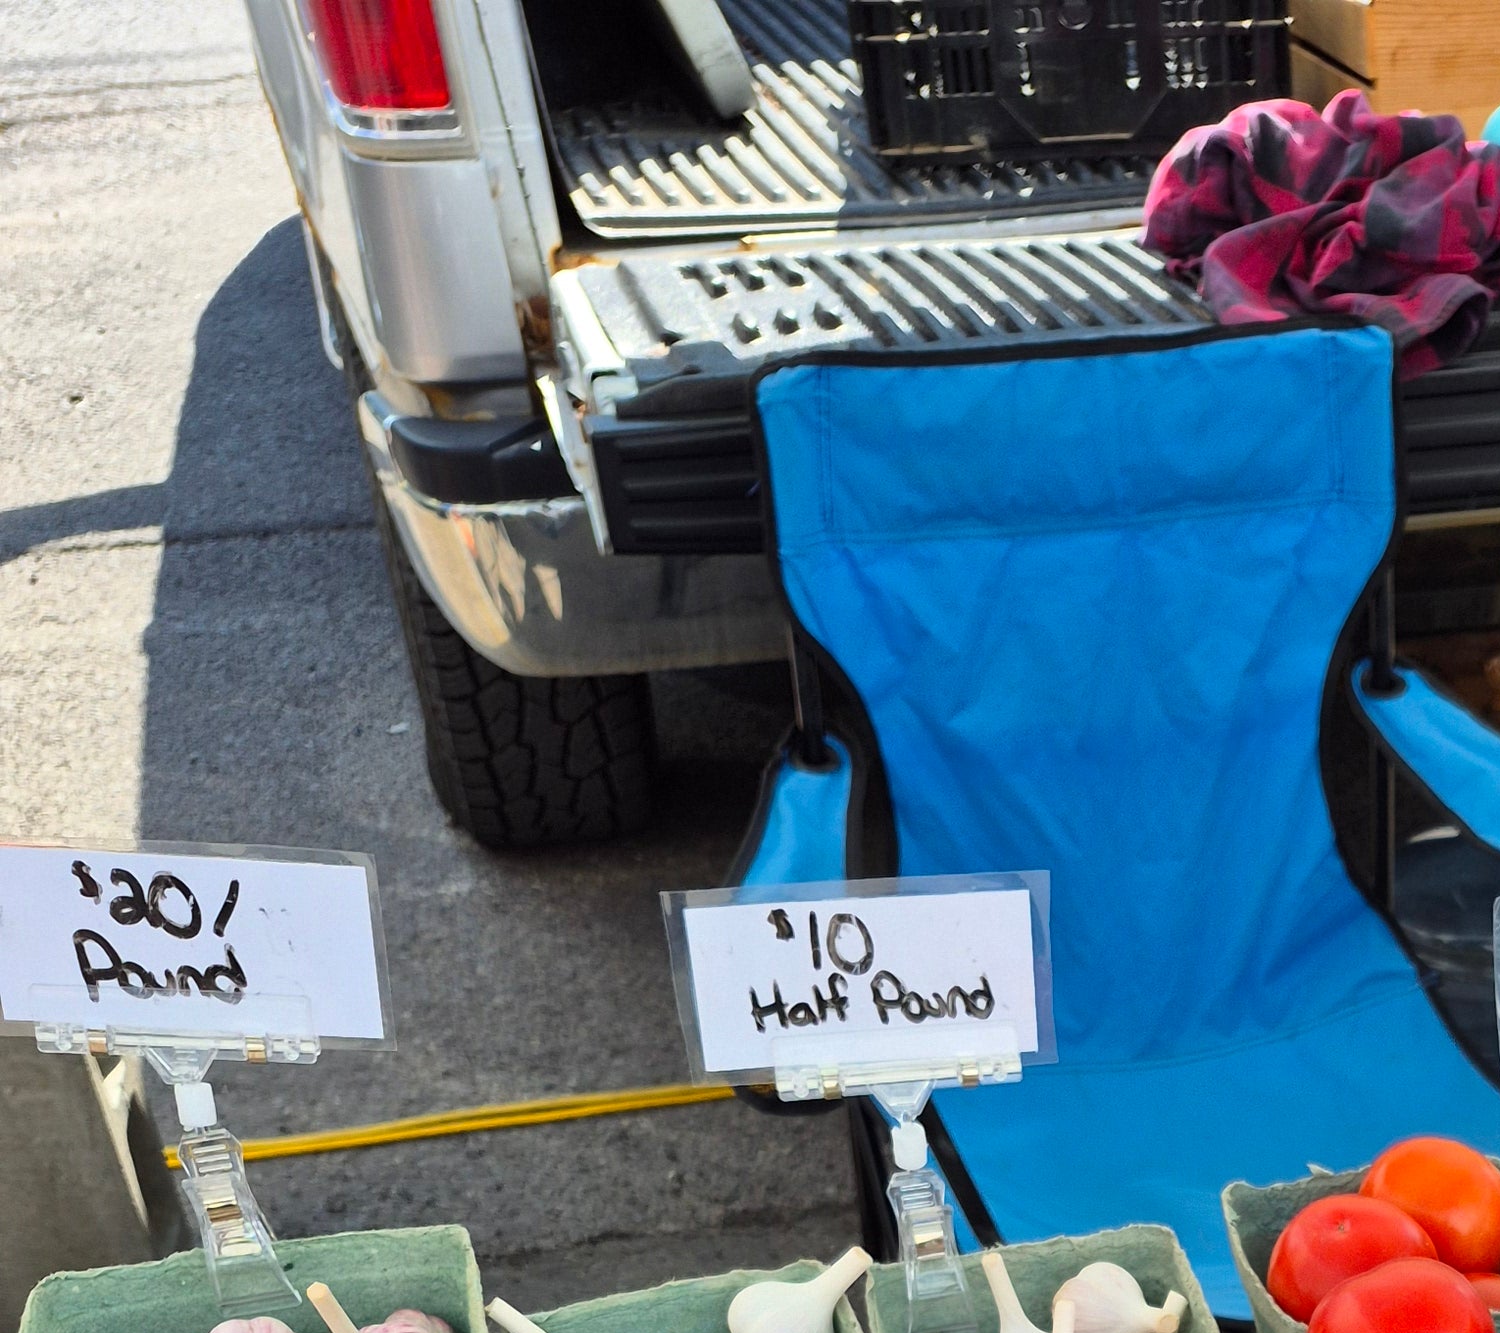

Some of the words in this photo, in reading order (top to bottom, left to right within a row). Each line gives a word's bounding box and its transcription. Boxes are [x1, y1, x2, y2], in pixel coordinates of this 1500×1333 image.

[72, 928, 248, 1005] Pound
[748, 972, 850, 1034] Half
[870, 969, 995, 1025] Pound
